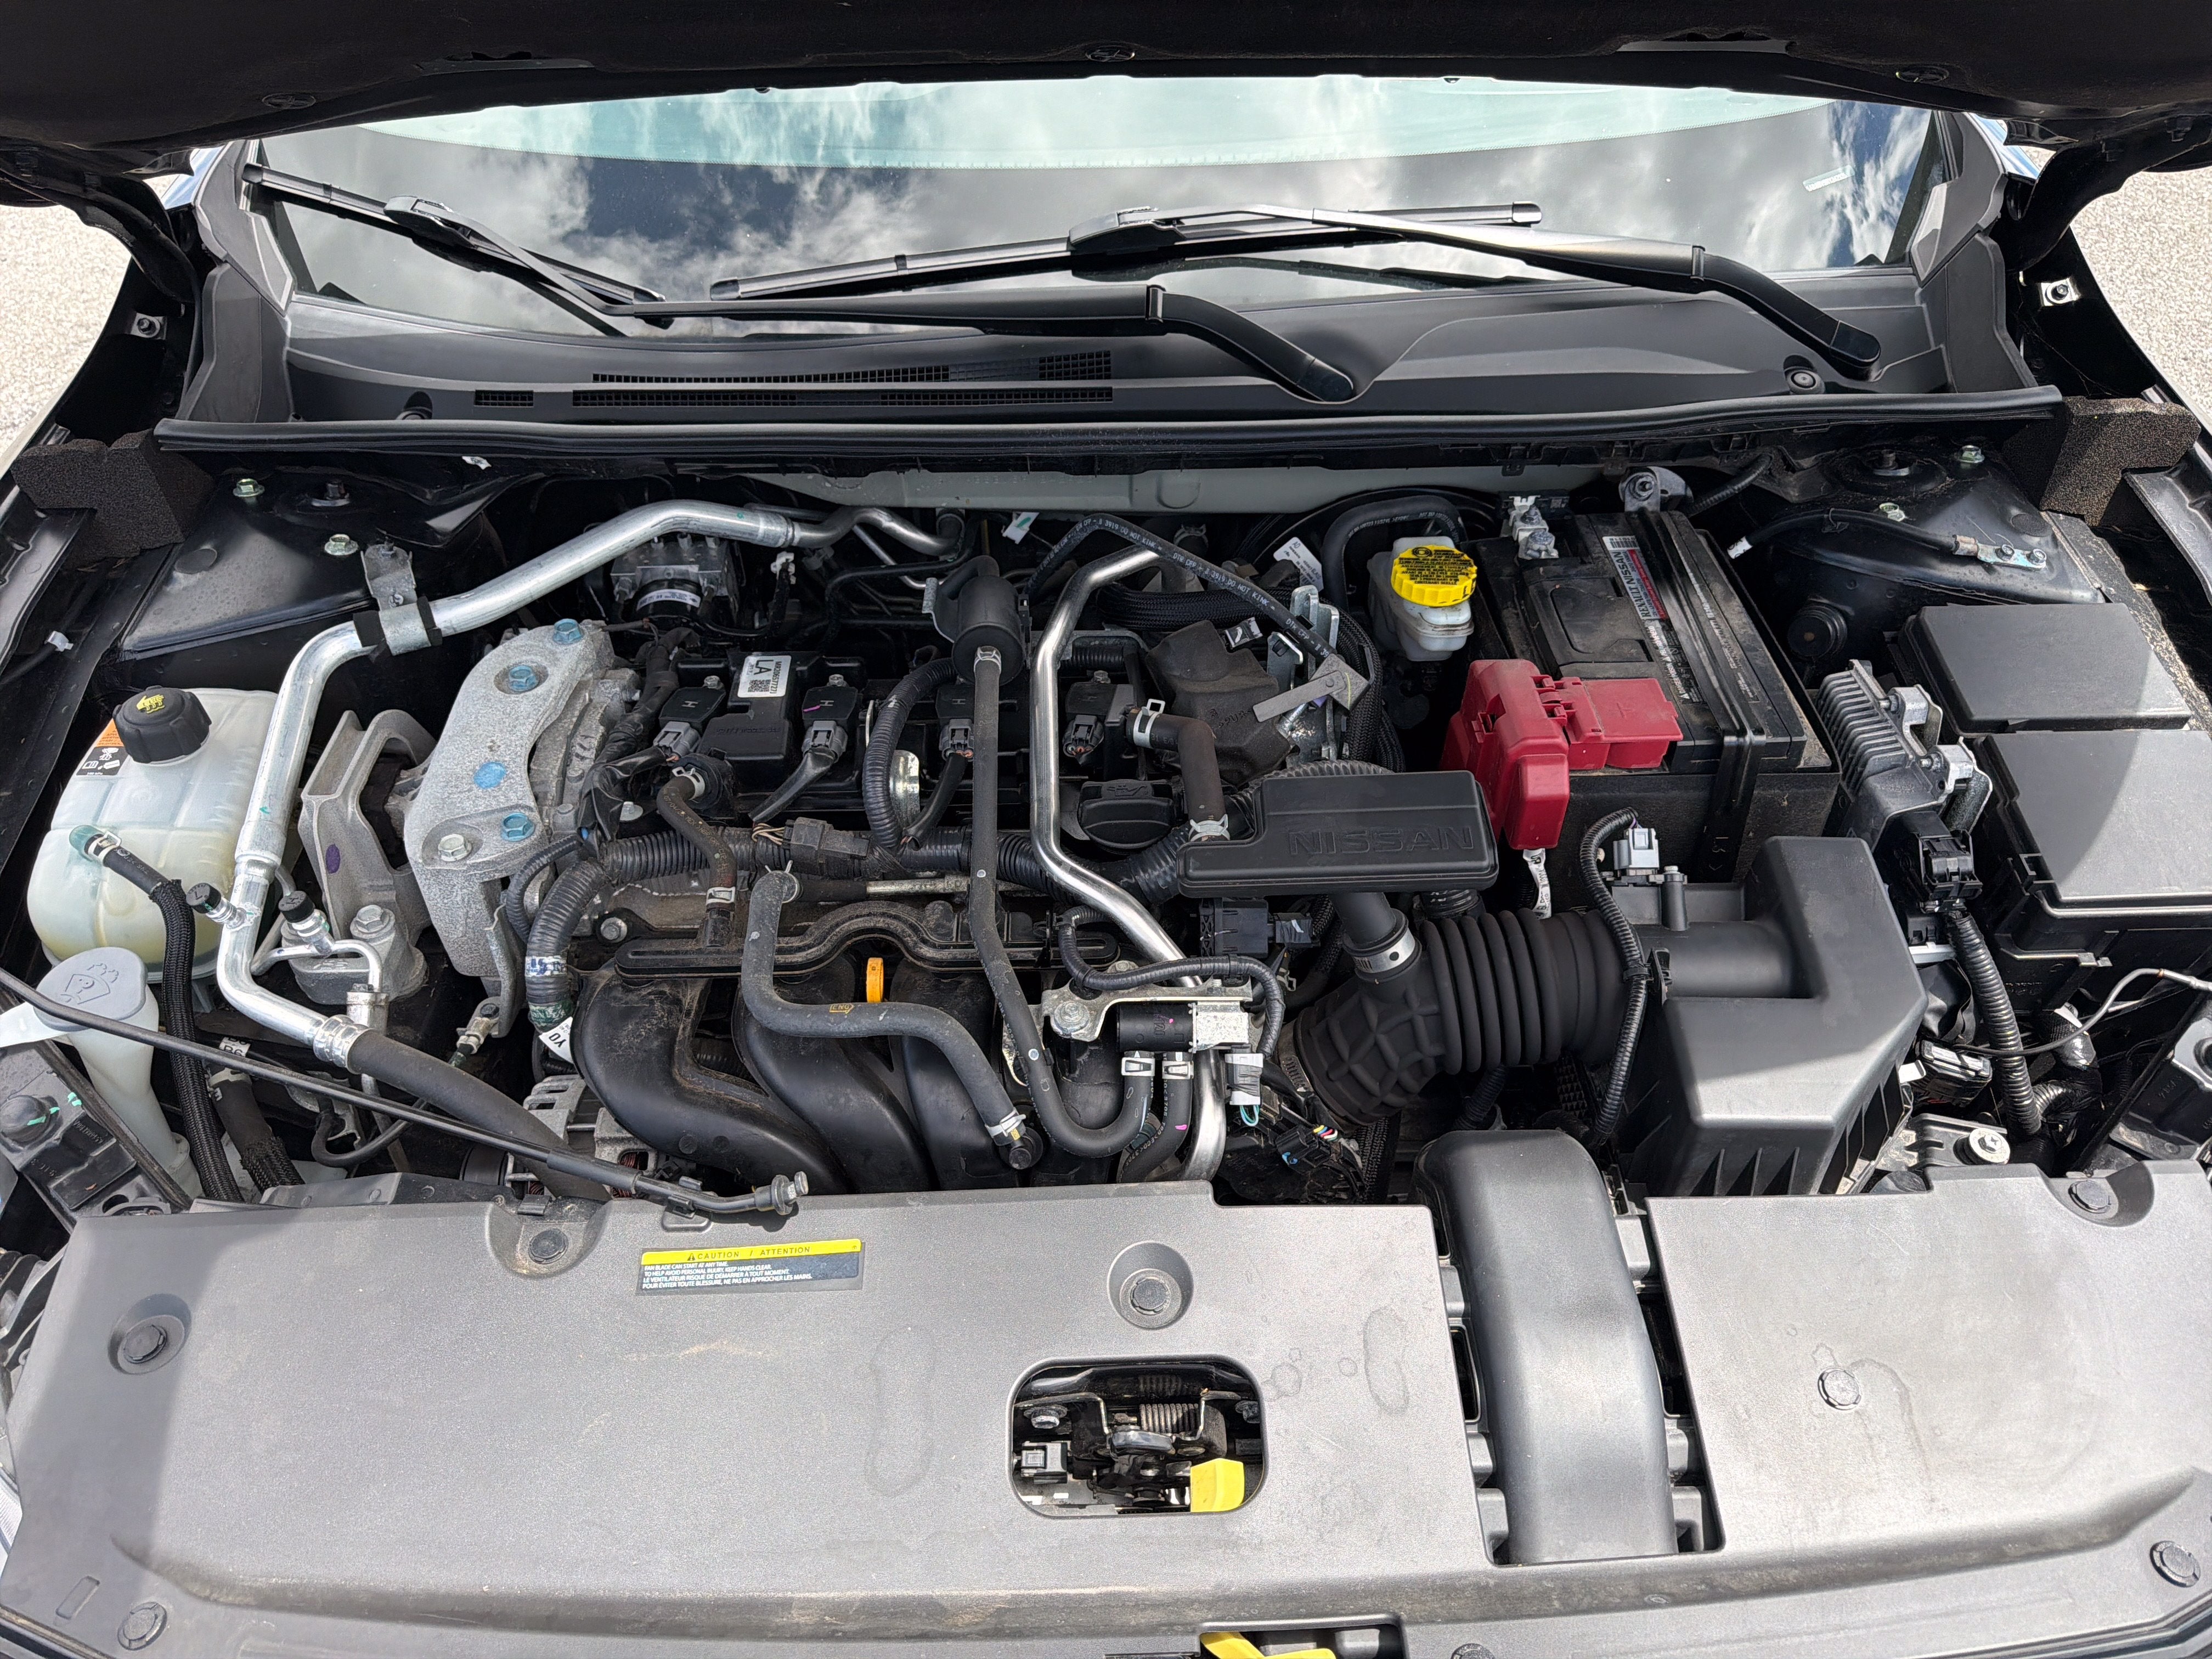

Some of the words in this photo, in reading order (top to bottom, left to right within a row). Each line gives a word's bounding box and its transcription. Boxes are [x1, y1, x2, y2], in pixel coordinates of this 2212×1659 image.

[1612, 551, 1636, 585] NISSAN
[1237, 584, 1251, 594] NOT
[1251, 591, 1271, 606] KINK
[1628, 585, 1652, 618] RENAULT
[753, 659, 774, 675] LA
[1288, 825, 1474, 855] NISSAN
[697, 1251, 740, 1260] CAUTION
[760, 1246, 810, 1256] ATTENTION
[751, 1275, 783, 1283] APPROCHER
